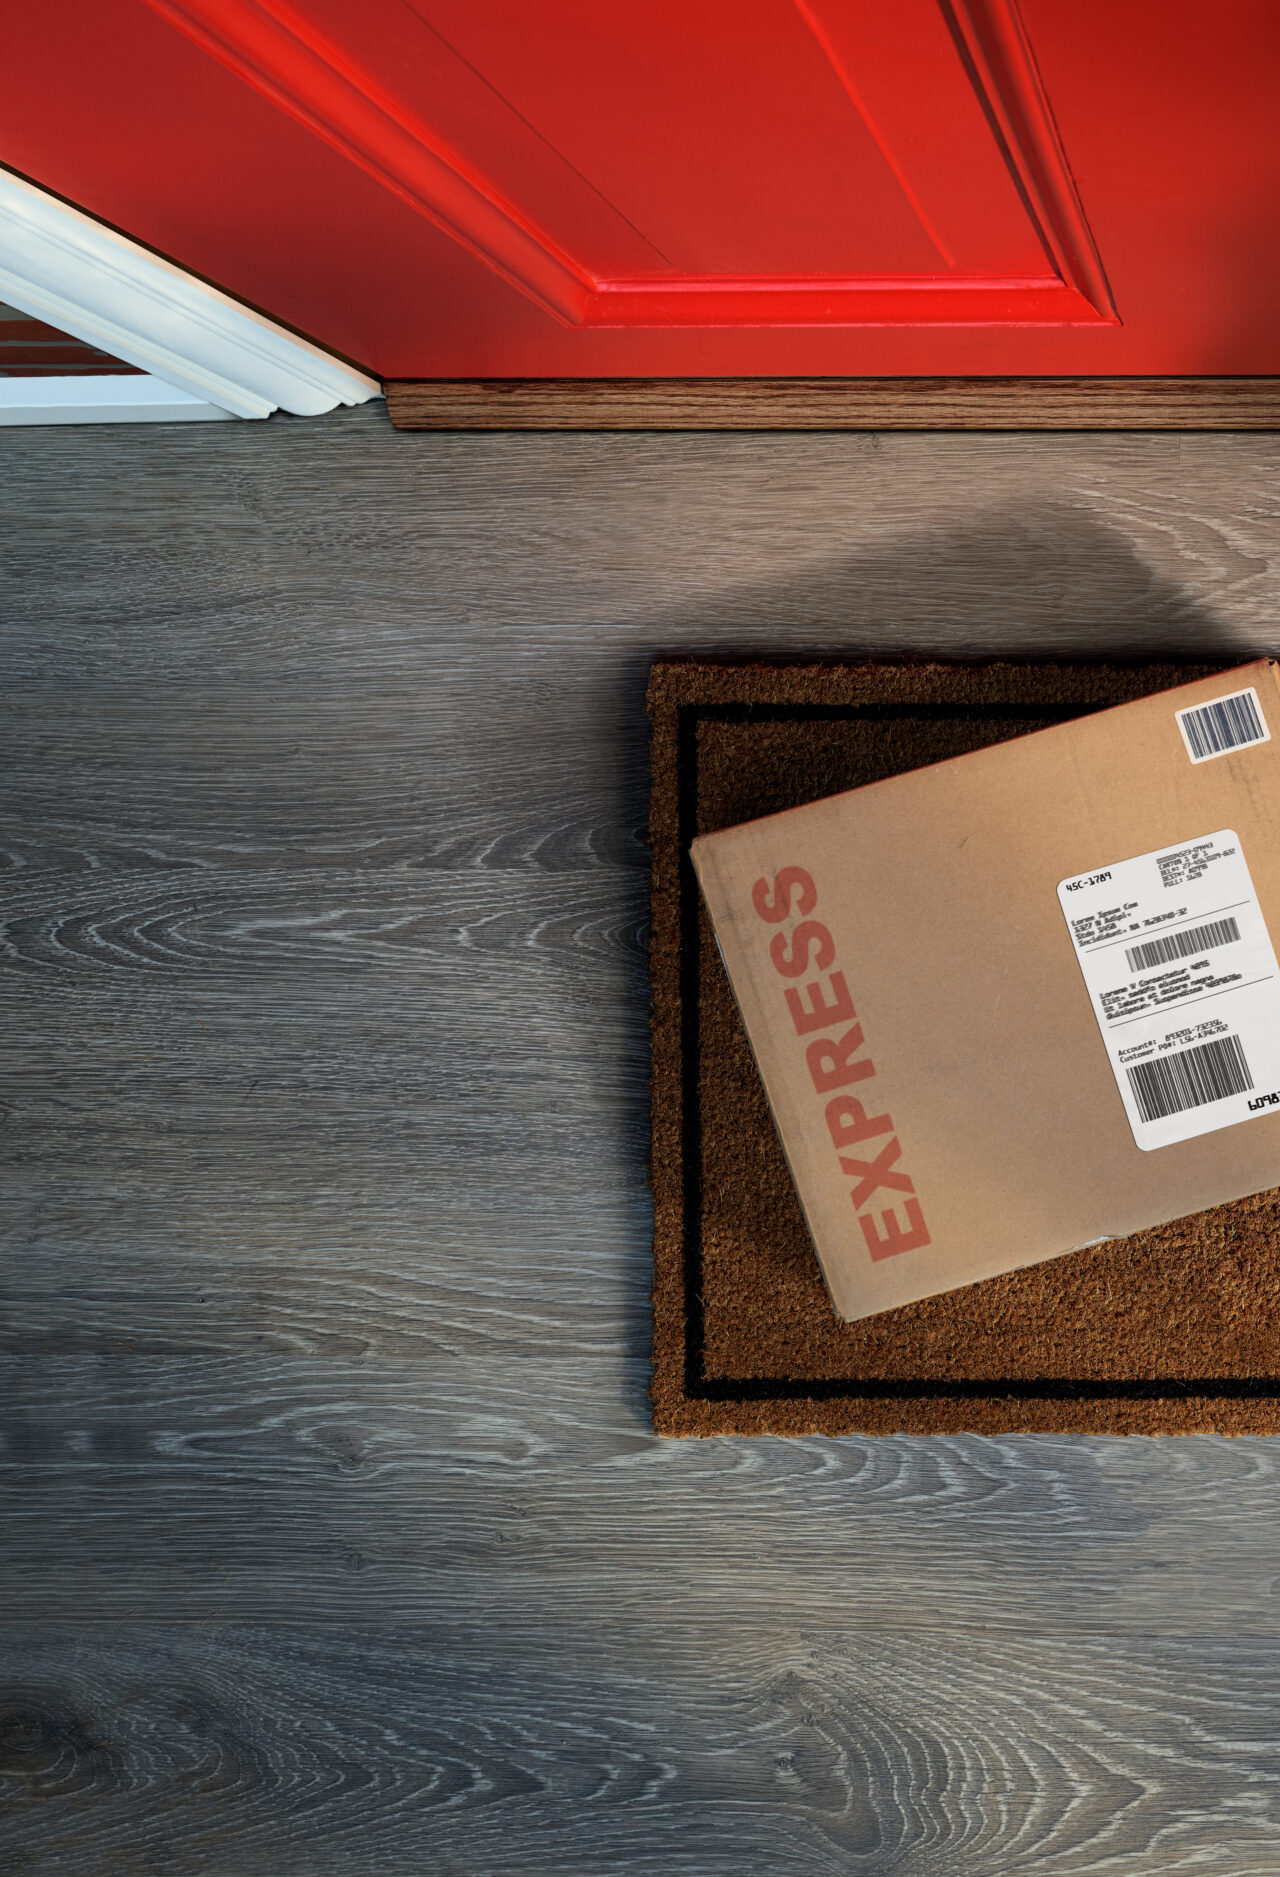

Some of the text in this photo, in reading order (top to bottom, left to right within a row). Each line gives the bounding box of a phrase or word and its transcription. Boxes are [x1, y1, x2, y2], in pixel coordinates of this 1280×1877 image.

[1158, 859, 1183, 870] CARTON
[1066, 871, 1112, 892] 45C-1789
[1118, 1039, 1157, 1057] Account#:
[1120, 1048, 1155, 1063] Customer
[752, 865, 932, 1262] EXPRESS
